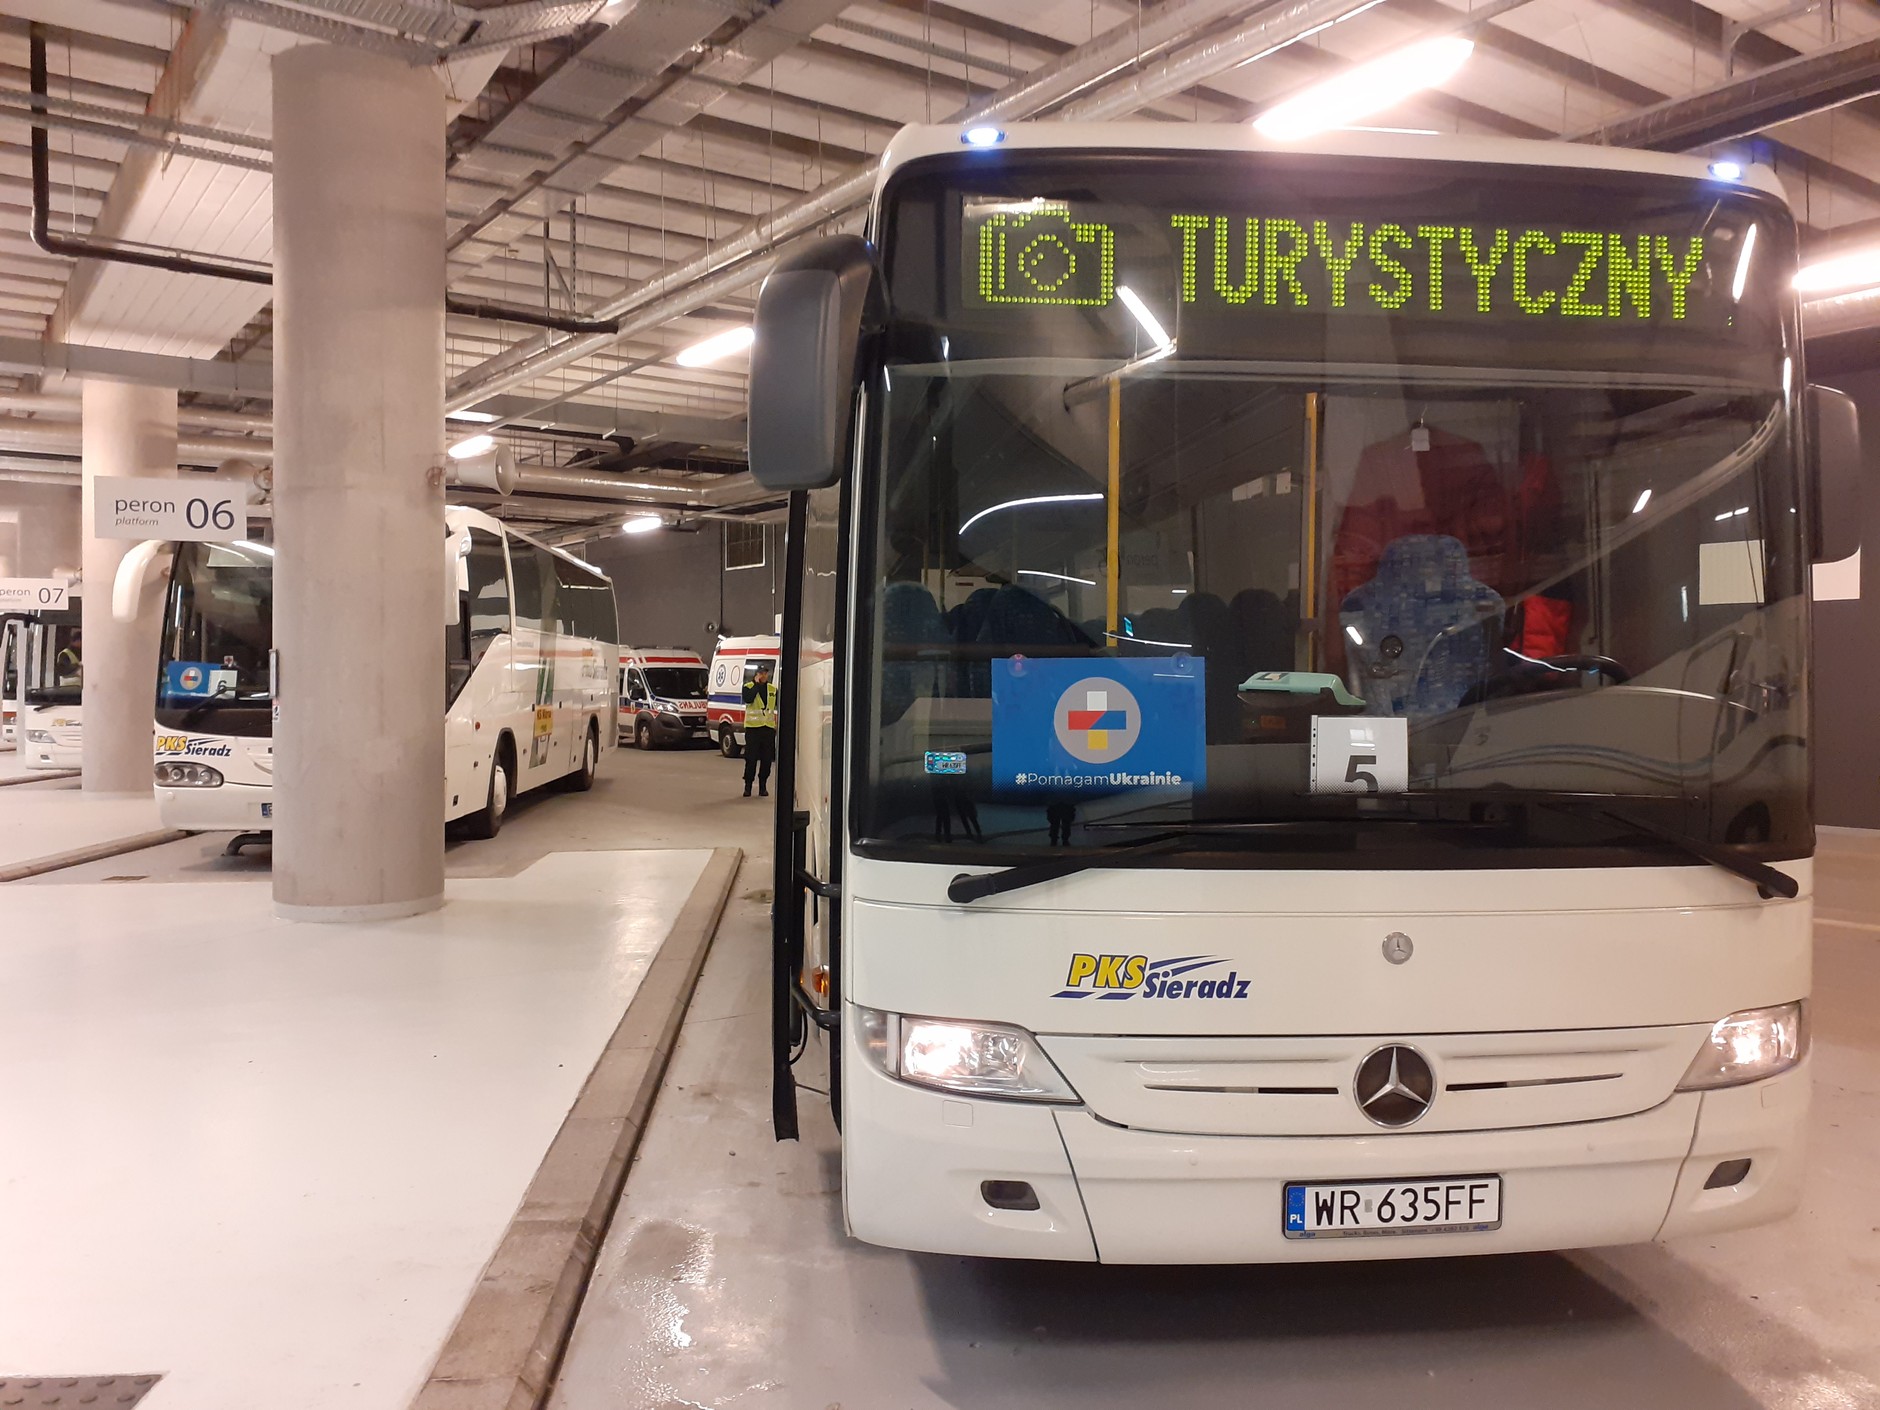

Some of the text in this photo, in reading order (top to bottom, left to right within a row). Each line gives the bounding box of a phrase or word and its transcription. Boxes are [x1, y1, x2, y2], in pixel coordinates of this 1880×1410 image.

[1170, 212, 1704, 320] TURYSTYCZNY
[115, 498, 235, 531] peron 06
[115, 516, 159, 527] platform
[0, 587, 64, 604] peron 07
[156, 736, 232, 757] PKS Sieradz
[1014, 771, 1183, 788] #PomagamUkrainie
[1344, 754, 1379, 792] 5
[1065, 953, 1252, 1001] PKS Sieradz
[1314, 1183, 1490, 1226] WR 635FF
[1289, 1214, 1303, 1224] PL
